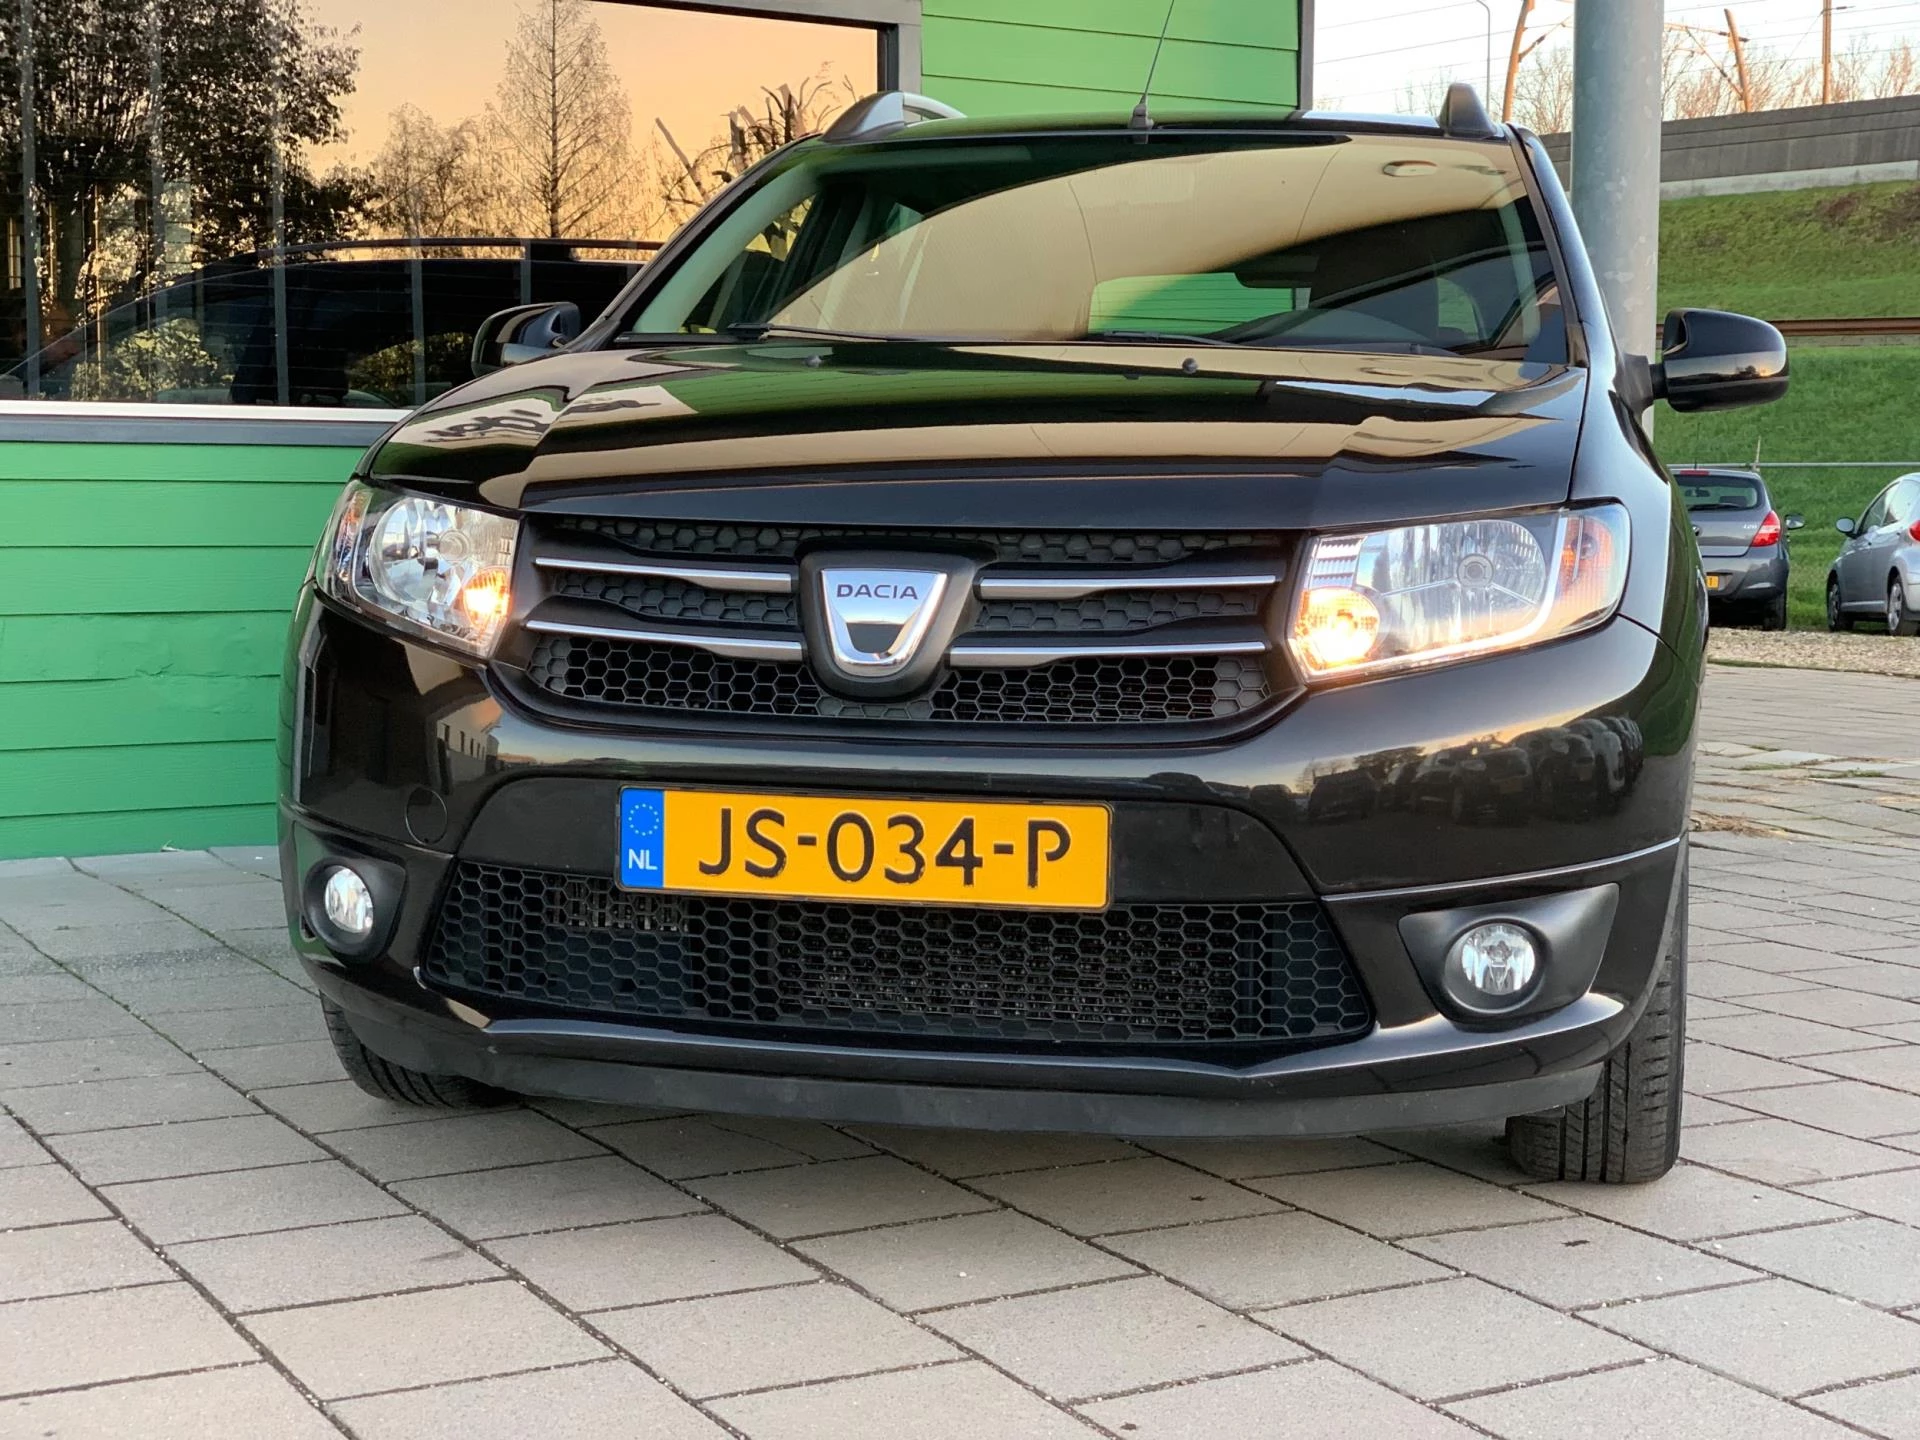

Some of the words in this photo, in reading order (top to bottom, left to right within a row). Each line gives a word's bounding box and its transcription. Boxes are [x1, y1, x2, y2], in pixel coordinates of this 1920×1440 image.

[836, 583, 918, 600] DACIA
[699, 807, 1071, 888] JS-034-P
[628, 848, 658, 870] NL
